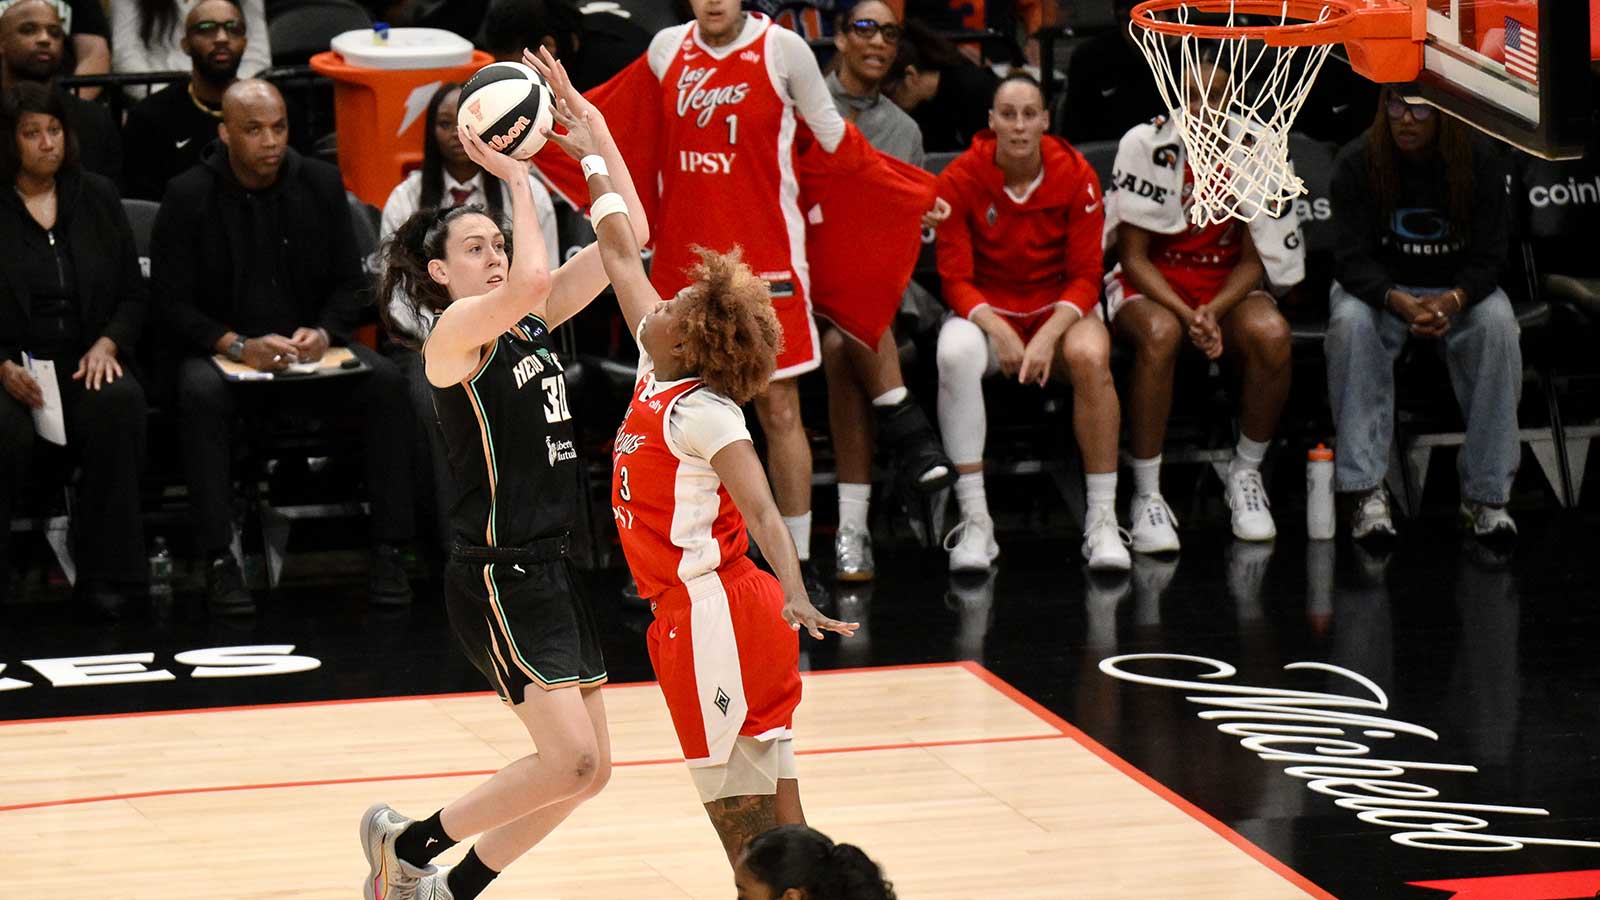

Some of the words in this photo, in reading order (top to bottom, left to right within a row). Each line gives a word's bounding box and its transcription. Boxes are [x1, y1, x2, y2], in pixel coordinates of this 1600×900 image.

[677, 65, 706, 90] Las
[677, 67, 750, 127] Vegas
[488, 115, 531, 151] ilson
[726, 114, 737, 144] 1
[680, 150, 736, 174] IPSY
[1295, 197, 1331, 221] as
[512, 353, 546, 390] NEW
[541, 373, 573, 424] 30
[649, 400, 663, 414] ally
[620, 466, 632, 502] 3
[612, 507, 635, 530] SY
[1098, 653, 1600, 852] Michelob
